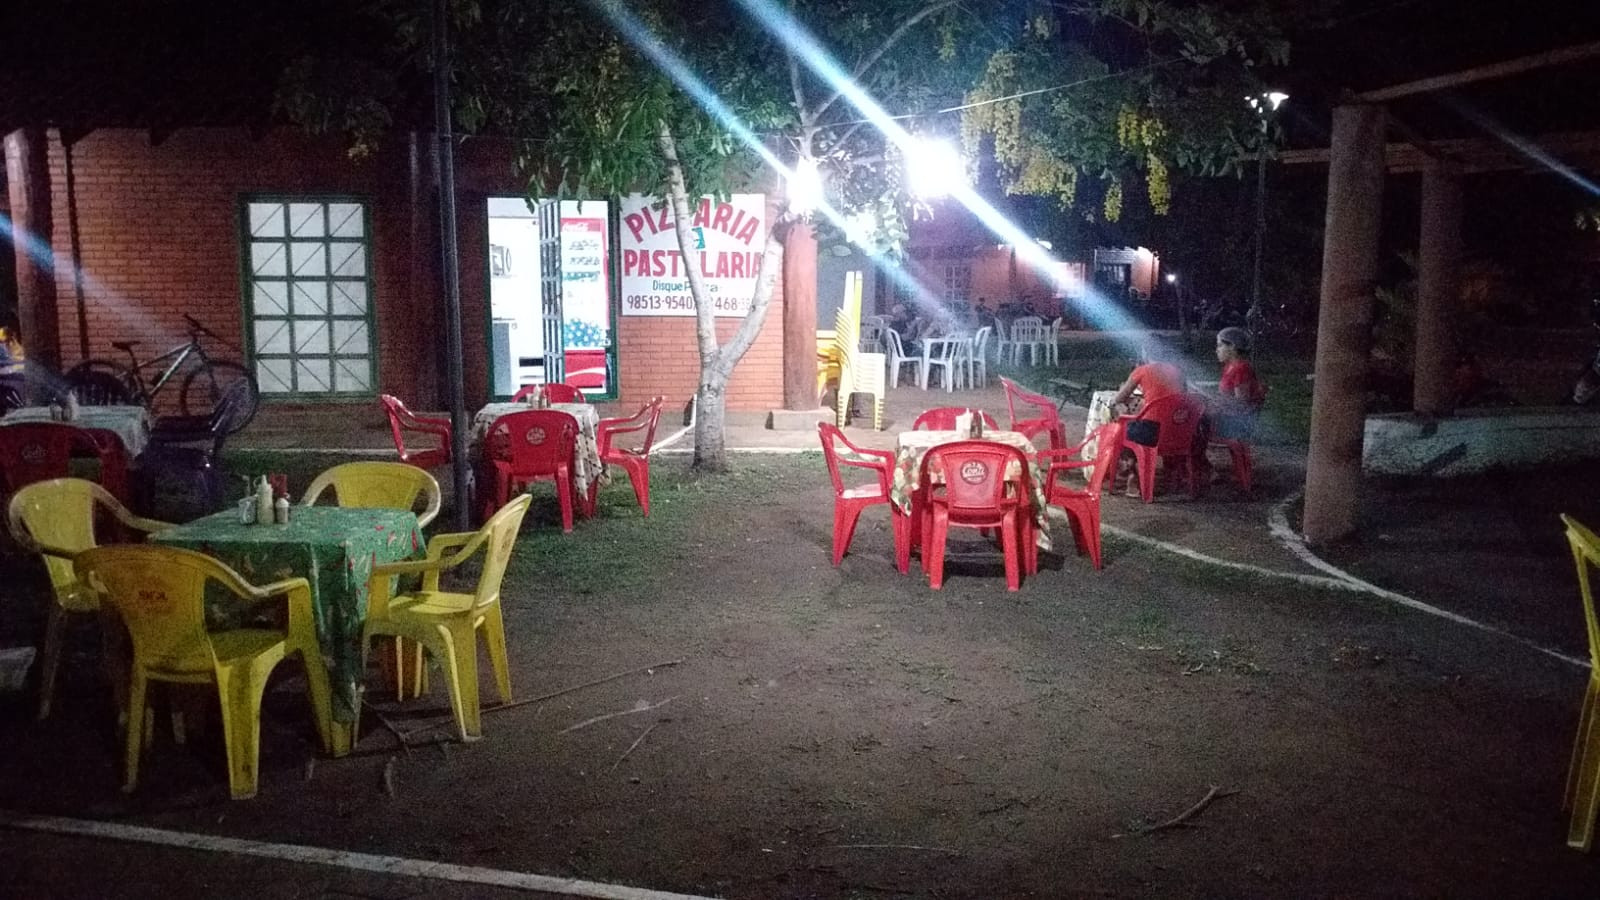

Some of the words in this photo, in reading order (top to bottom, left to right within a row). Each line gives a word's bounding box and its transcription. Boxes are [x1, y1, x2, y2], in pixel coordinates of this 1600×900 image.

[623, 198, 760, 245] PIZARIA
[623, 249, 761, 279] PASTLARIA
[652, 279, 682, 293] Disque
